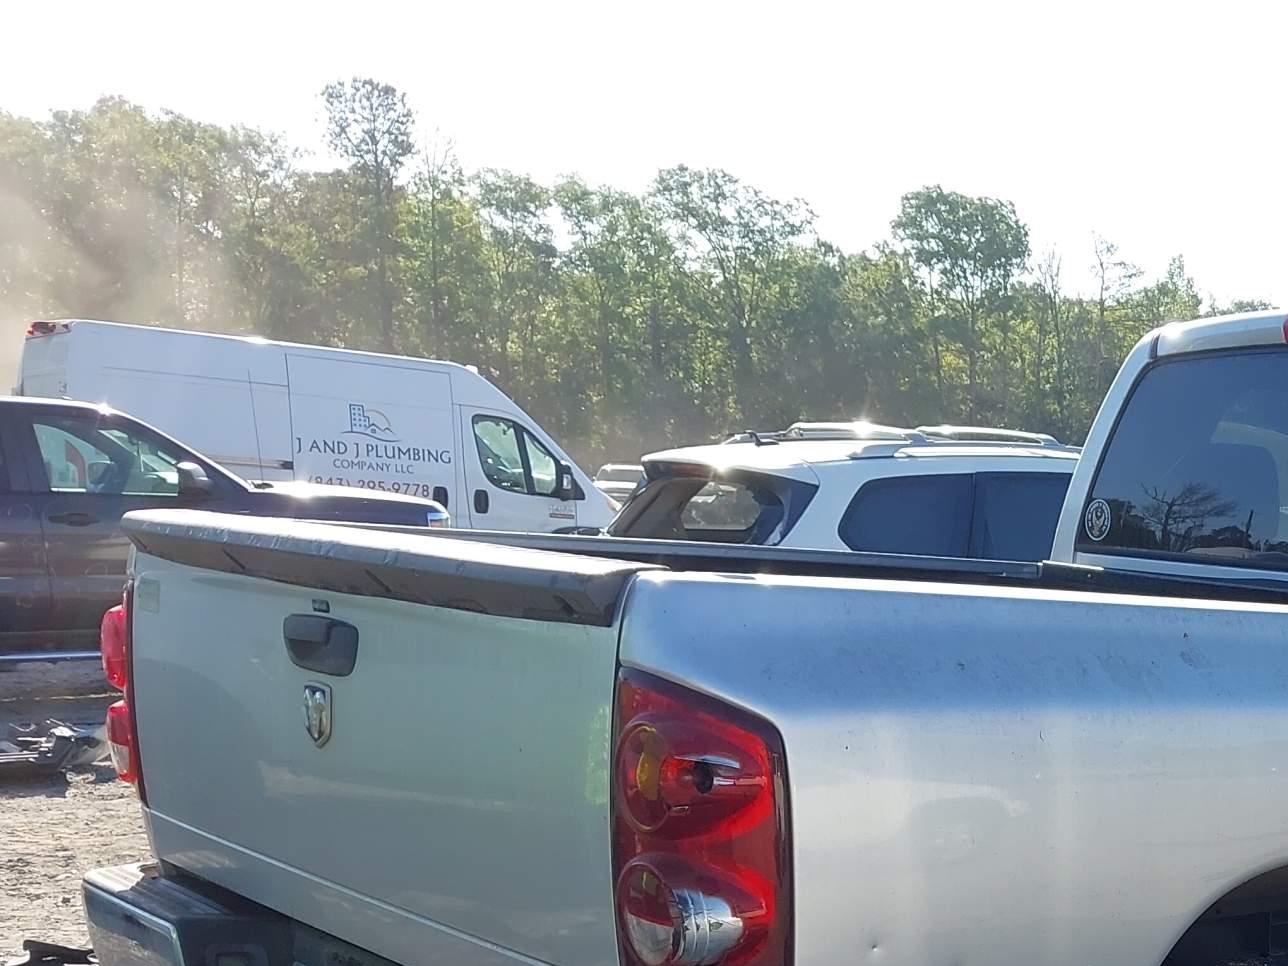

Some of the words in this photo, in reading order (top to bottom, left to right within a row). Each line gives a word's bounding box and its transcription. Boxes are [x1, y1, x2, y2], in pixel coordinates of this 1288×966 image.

[295, 437, 302, 454] J
[309, 439, 348, 455] AND
[353, 442, 360, 459] J
[366, 443, 452, 464] PLUMBING
[333, 458, 391, 473] COMPANY
[395, 463, 415, 475] LLC
